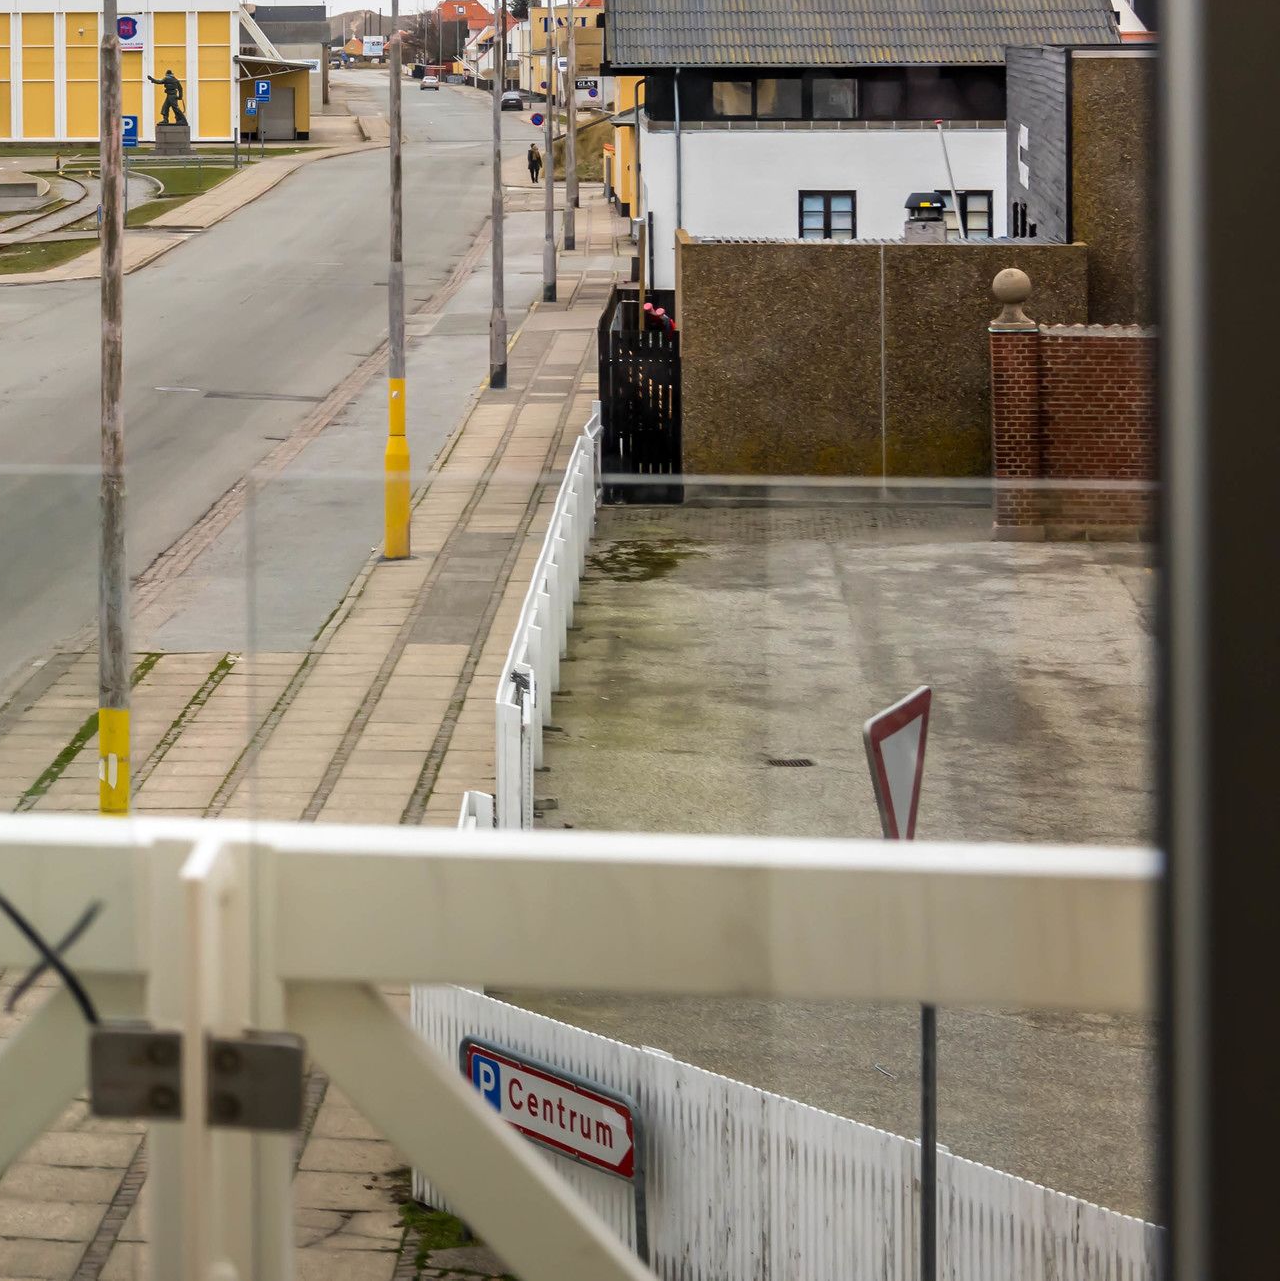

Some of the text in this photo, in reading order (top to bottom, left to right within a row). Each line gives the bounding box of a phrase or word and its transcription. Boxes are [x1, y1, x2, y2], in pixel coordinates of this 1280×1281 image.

[259, 82, 268, 94] P
[122, 118, 133, 134] P
[479, 1060, 613, 1149] P Centrum
